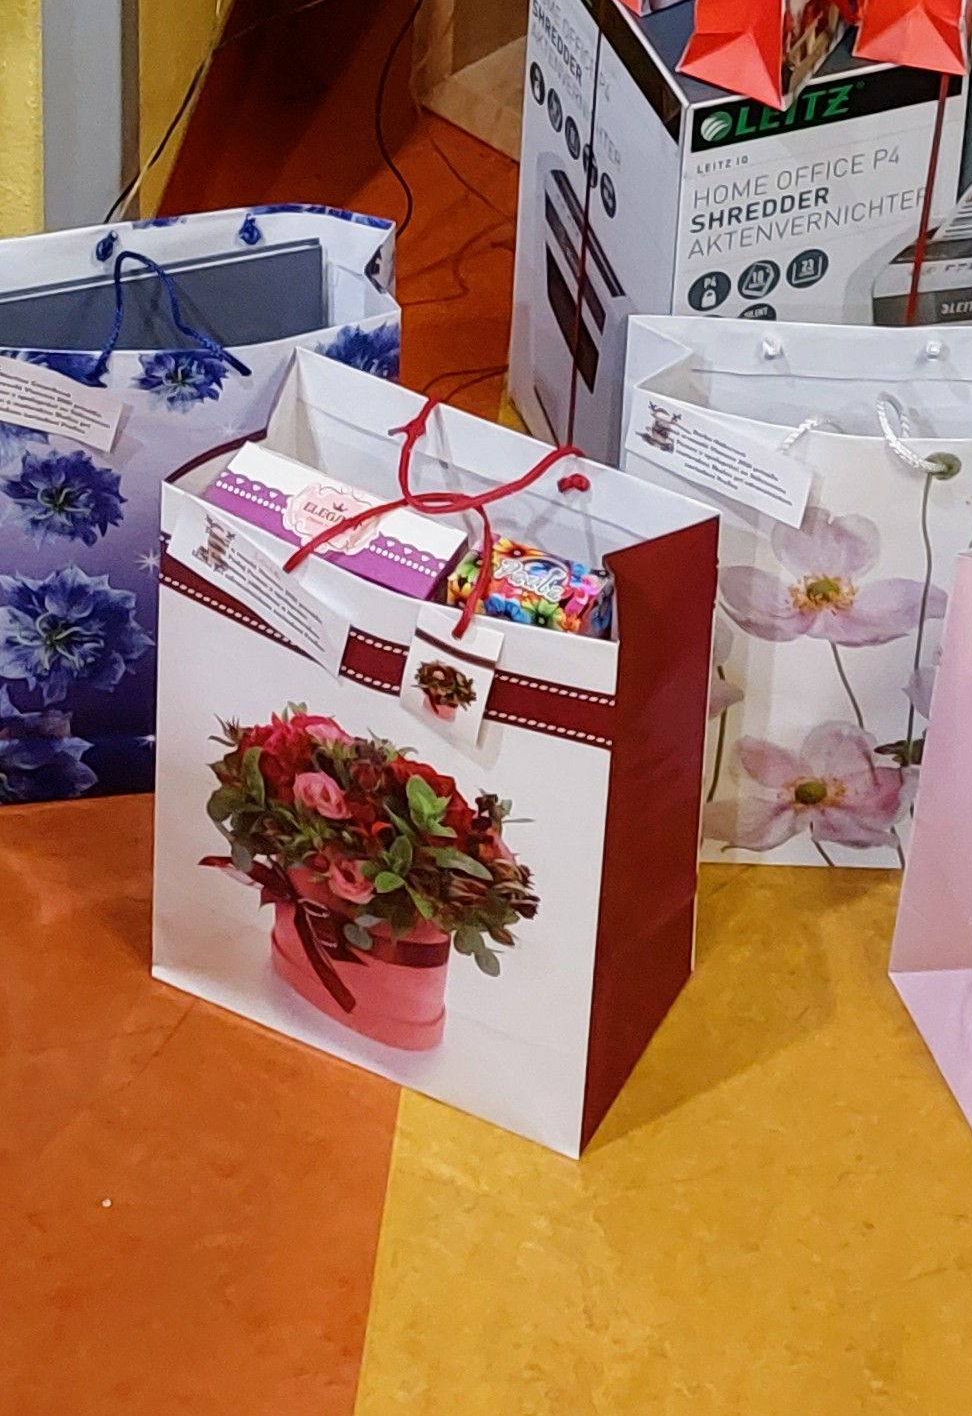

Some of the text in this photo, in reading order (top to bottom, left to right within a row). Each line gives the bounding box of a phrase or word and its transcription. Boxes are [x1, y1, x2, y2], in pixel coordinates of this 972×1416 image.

[532, 0, 583, 87] SHREDDER
[694, 146, 900, 209] HOME OFFICE P4
[696, 158, 732, 175] LEITZ
[690, 187, 830, 234] SHREDDER
[703, 276, 717, 289] P4
